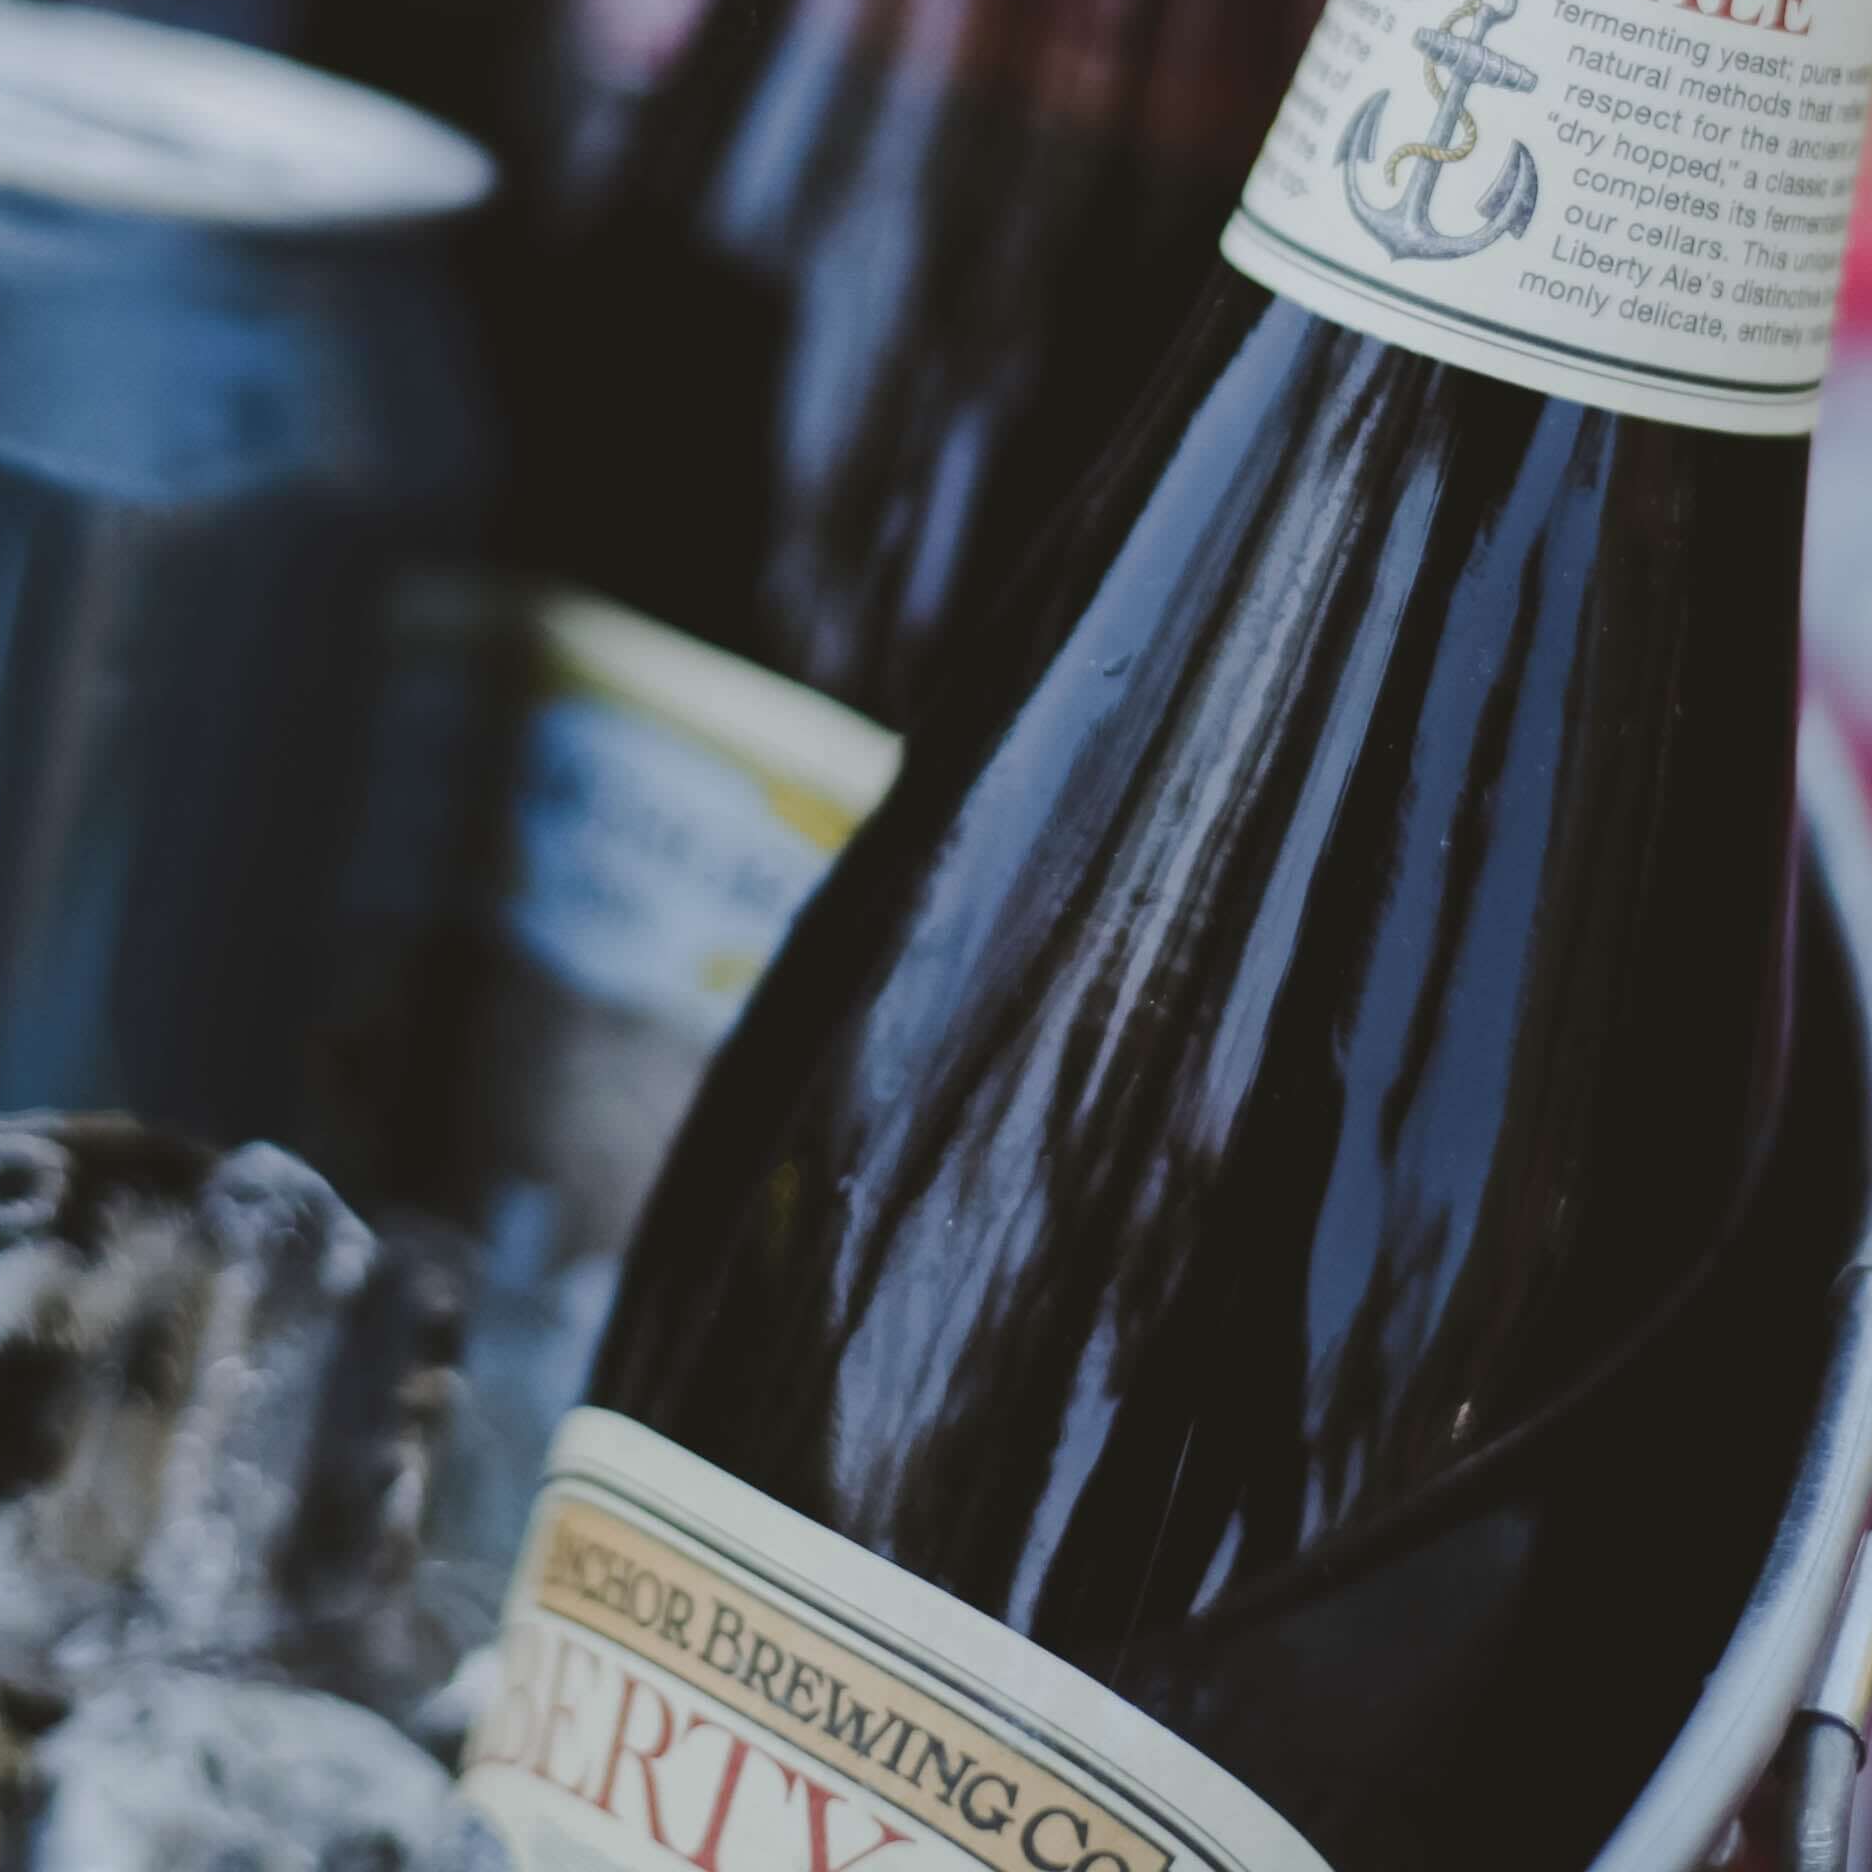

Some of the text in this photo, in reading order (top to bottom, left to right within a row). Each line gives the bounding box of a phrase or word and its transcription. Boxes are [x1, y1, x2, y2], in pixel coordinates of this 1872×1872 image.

[1566, 43, 1672, 91] natural
[1679, 76, 1792, 119] methods
[1798, 95, 1833, 123] that
[1718, 47, 1793, 81] yeast;
[1799, 61, 1842, 88] pure
[1547, 110, 1605, 157] "dry
[1742, 169, 1759, 190] a
[1765, 169, 1829, 199] classic
[1563, 83, 1682, 134] respect
[1692, 113, 1731, 145] for
[1740, 124, 1779, 155] the
[1573, 167, 1720, 221] completes
[1728, 199, 1757, 229] its
[1551, 233, 1653, 288] Liberty
[1659, 263, 1725, 300] Ale's
[1564, 203, 1619, 235] our
[1627, 222, 1728, 263] cellars.
[1743, 239, 1788, 271] This
[1518, 271, 1610, 318] monly
[1618, 295, 1728, 344] delicate,
[696, 1596, 1019, 1835] BREWING
